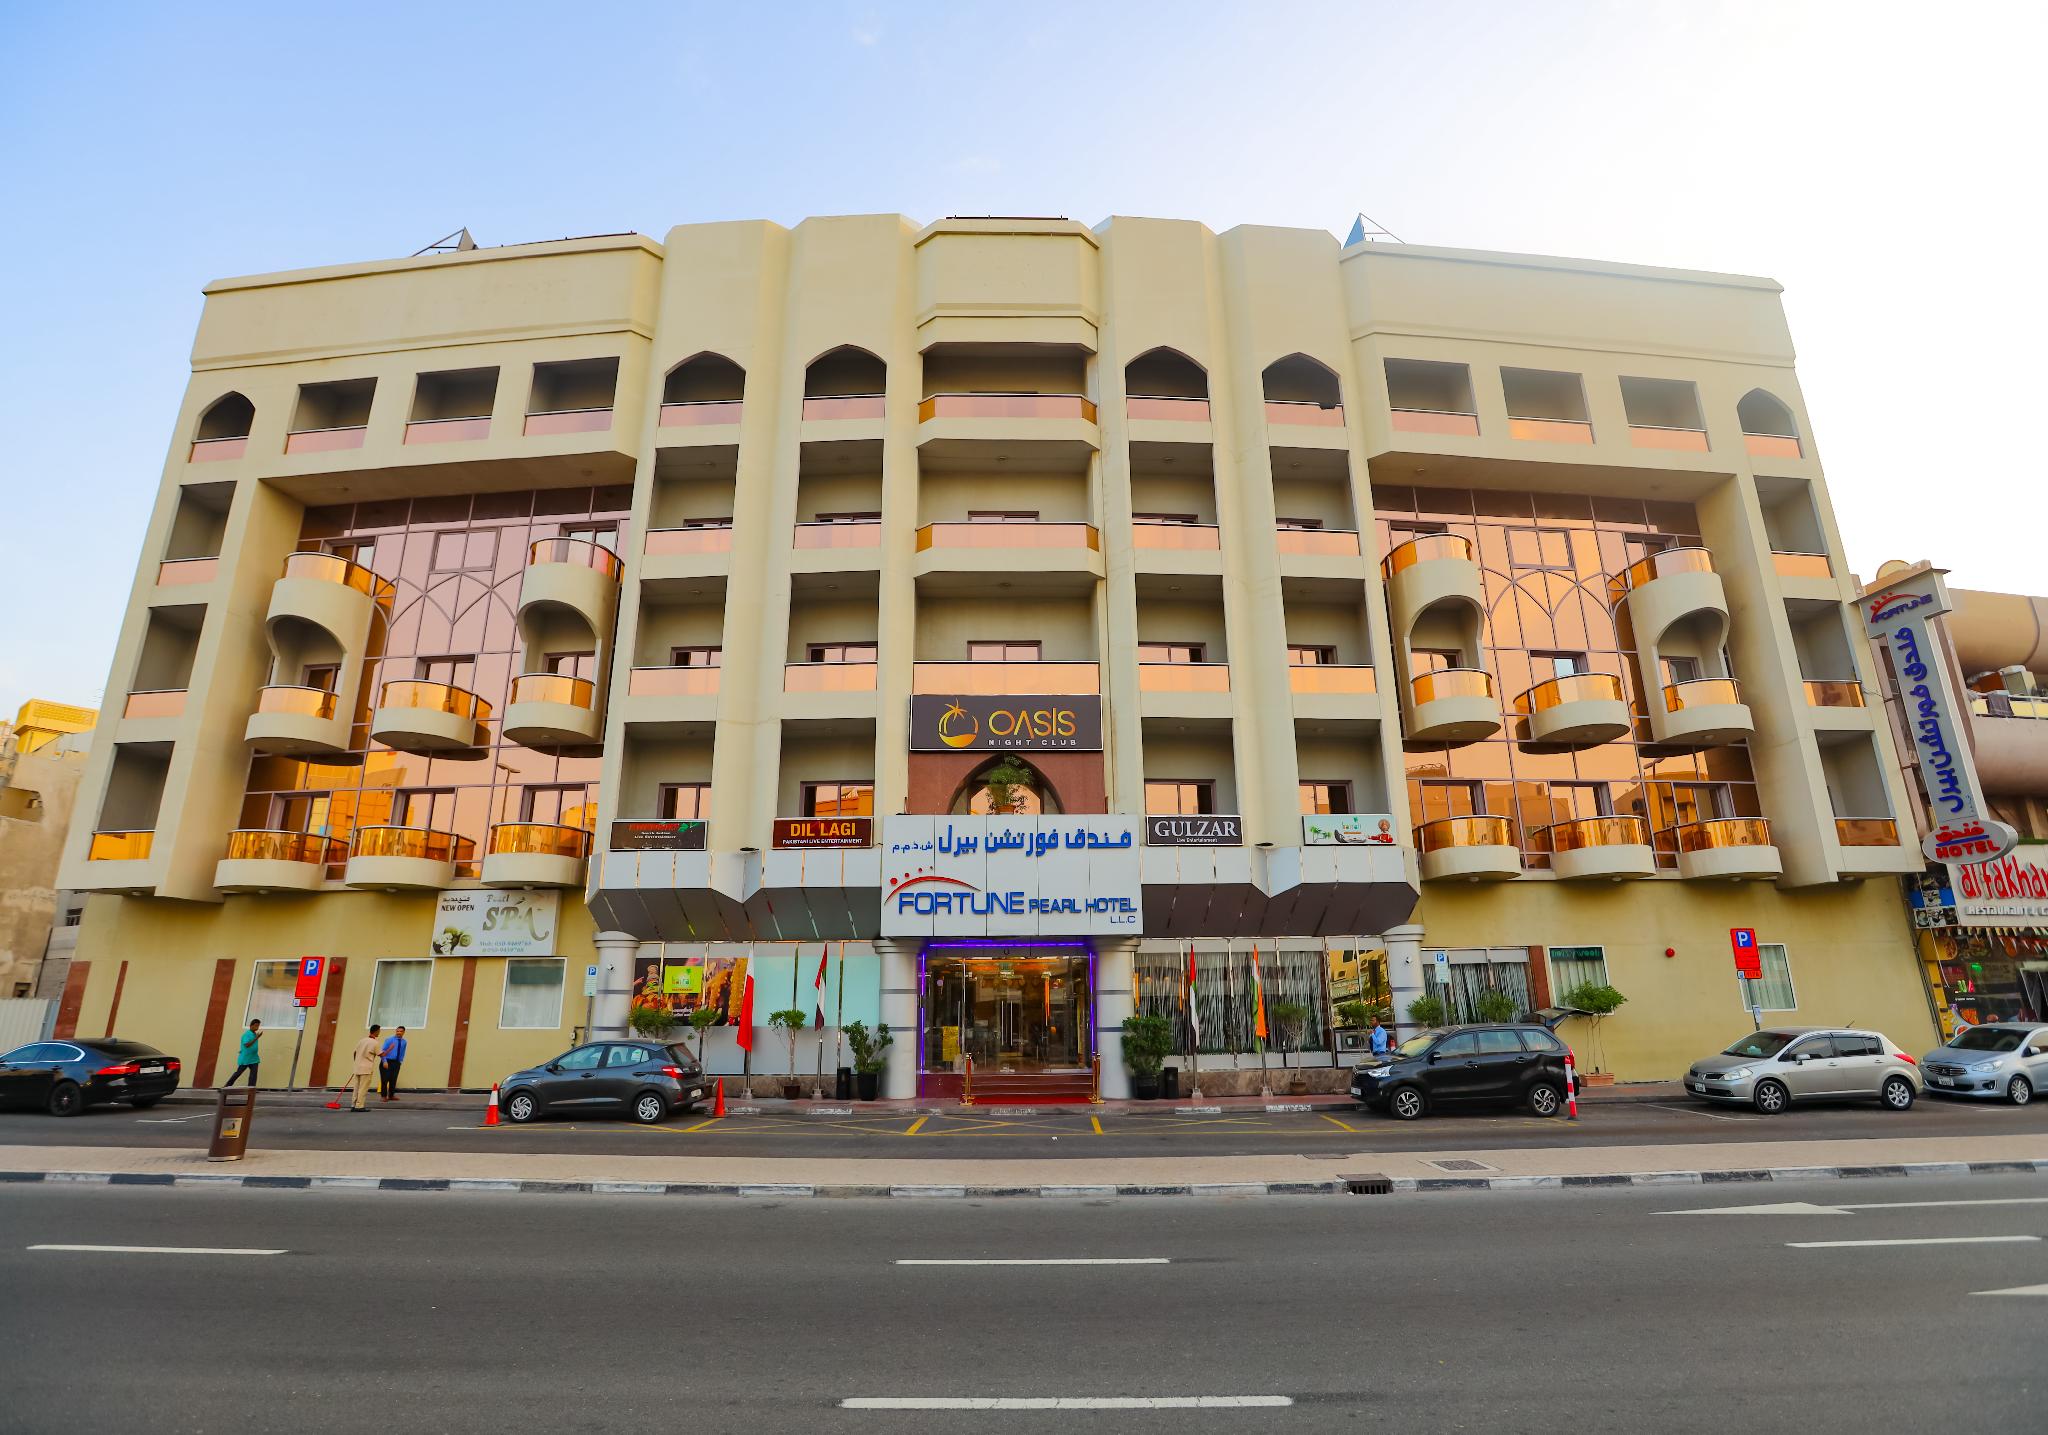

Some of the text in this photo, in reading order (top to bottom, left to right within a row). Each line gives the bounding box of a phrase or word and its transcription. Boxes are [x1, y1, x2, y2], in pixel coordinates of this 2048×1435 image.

[1874, 594, 1933, 624] FORTUNE
[988, 707, 1077, 739] OASIS
[790, 822, 856, 837] DIL LAGI
[1065, 828, 1132, 850] فندق
[1154, 820, 1239, 837] GULZAR
[1935, 821, 1985, 842] فندق
[938, 825, 978, 857] بيرل
[984, 828, 1059, 857] فورتشن
[1935, 840, 2001, 859] HOTEL
[440, 904, 475, 912] NEW OPEN
[898, 891, 1138, 915] FORTUNE PEARL HOTEL
[482, 906, 550, 941] SPA
[1738, 931, 1749, 947] P
[305, 959, 317, 975] P
